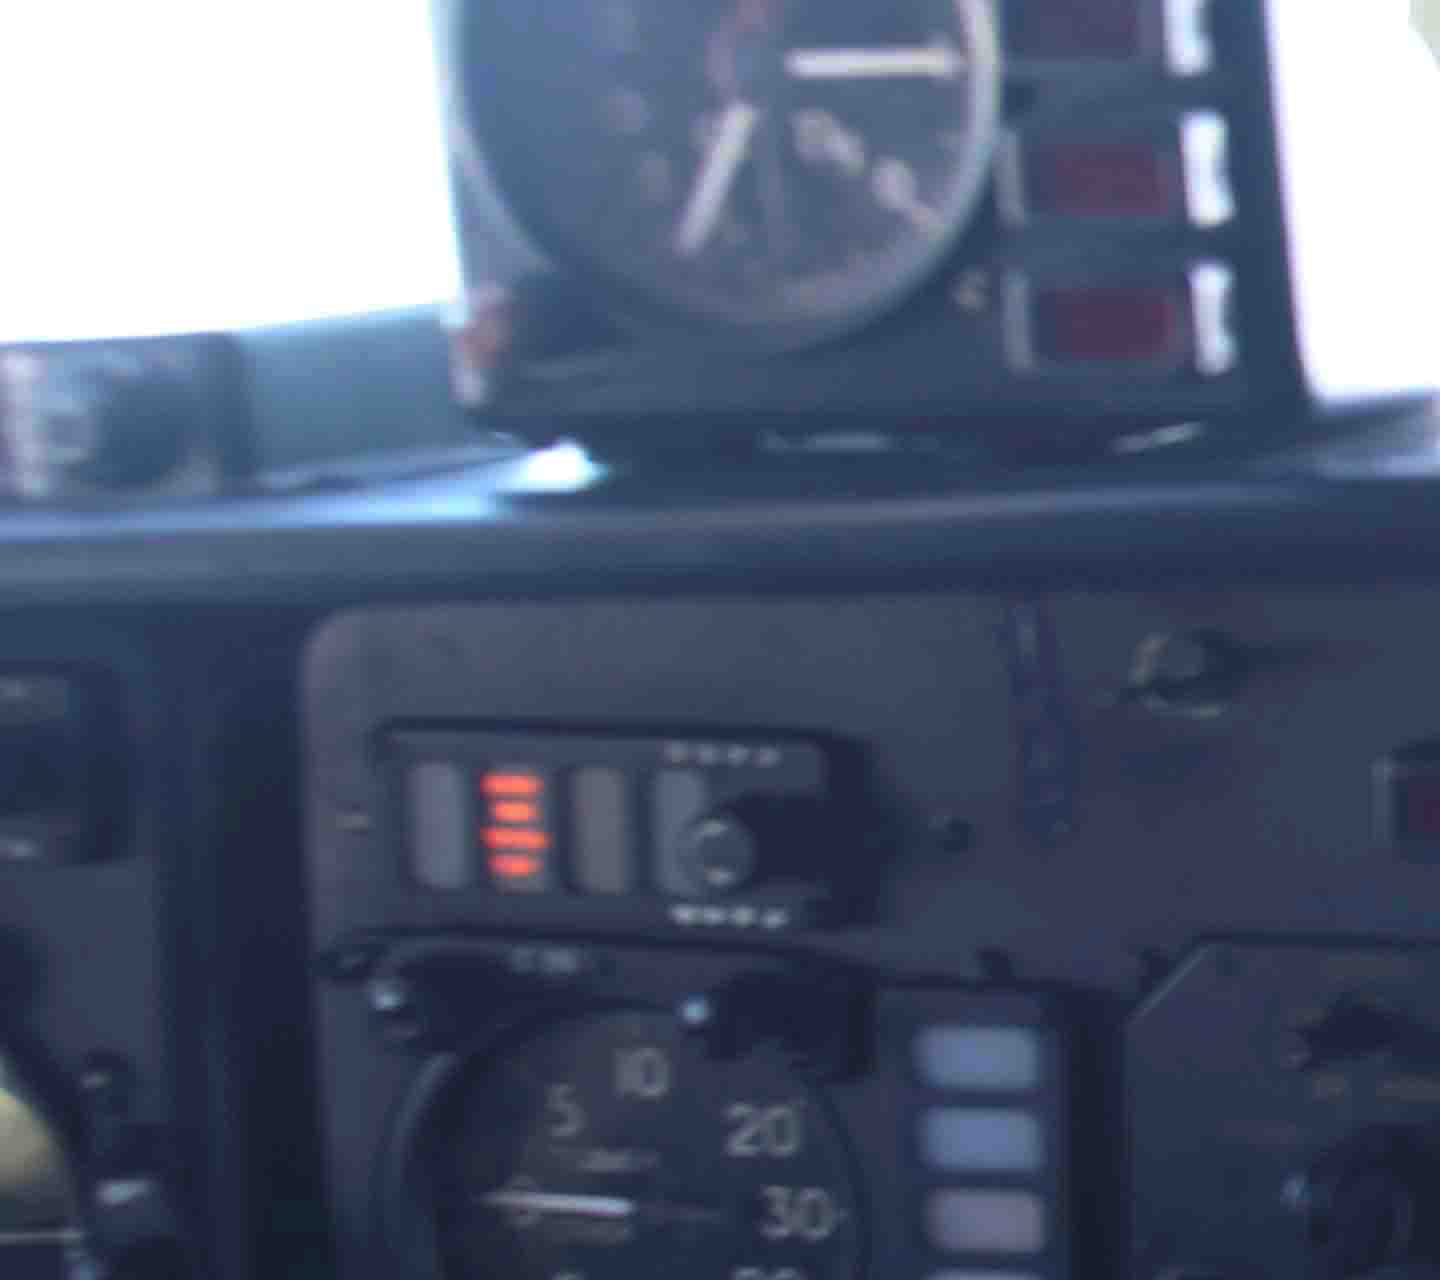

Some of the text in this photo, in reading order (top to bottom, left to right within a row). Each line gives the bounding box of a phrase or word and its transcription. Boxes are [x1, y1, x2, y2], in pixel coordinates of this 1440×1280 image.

[612, 1045, 676, 1101] 10
[545, 1082, 591, 1139] 5
[721, 1099, 804, 1159] 20
[757, 1184, 840, 1241] 30
